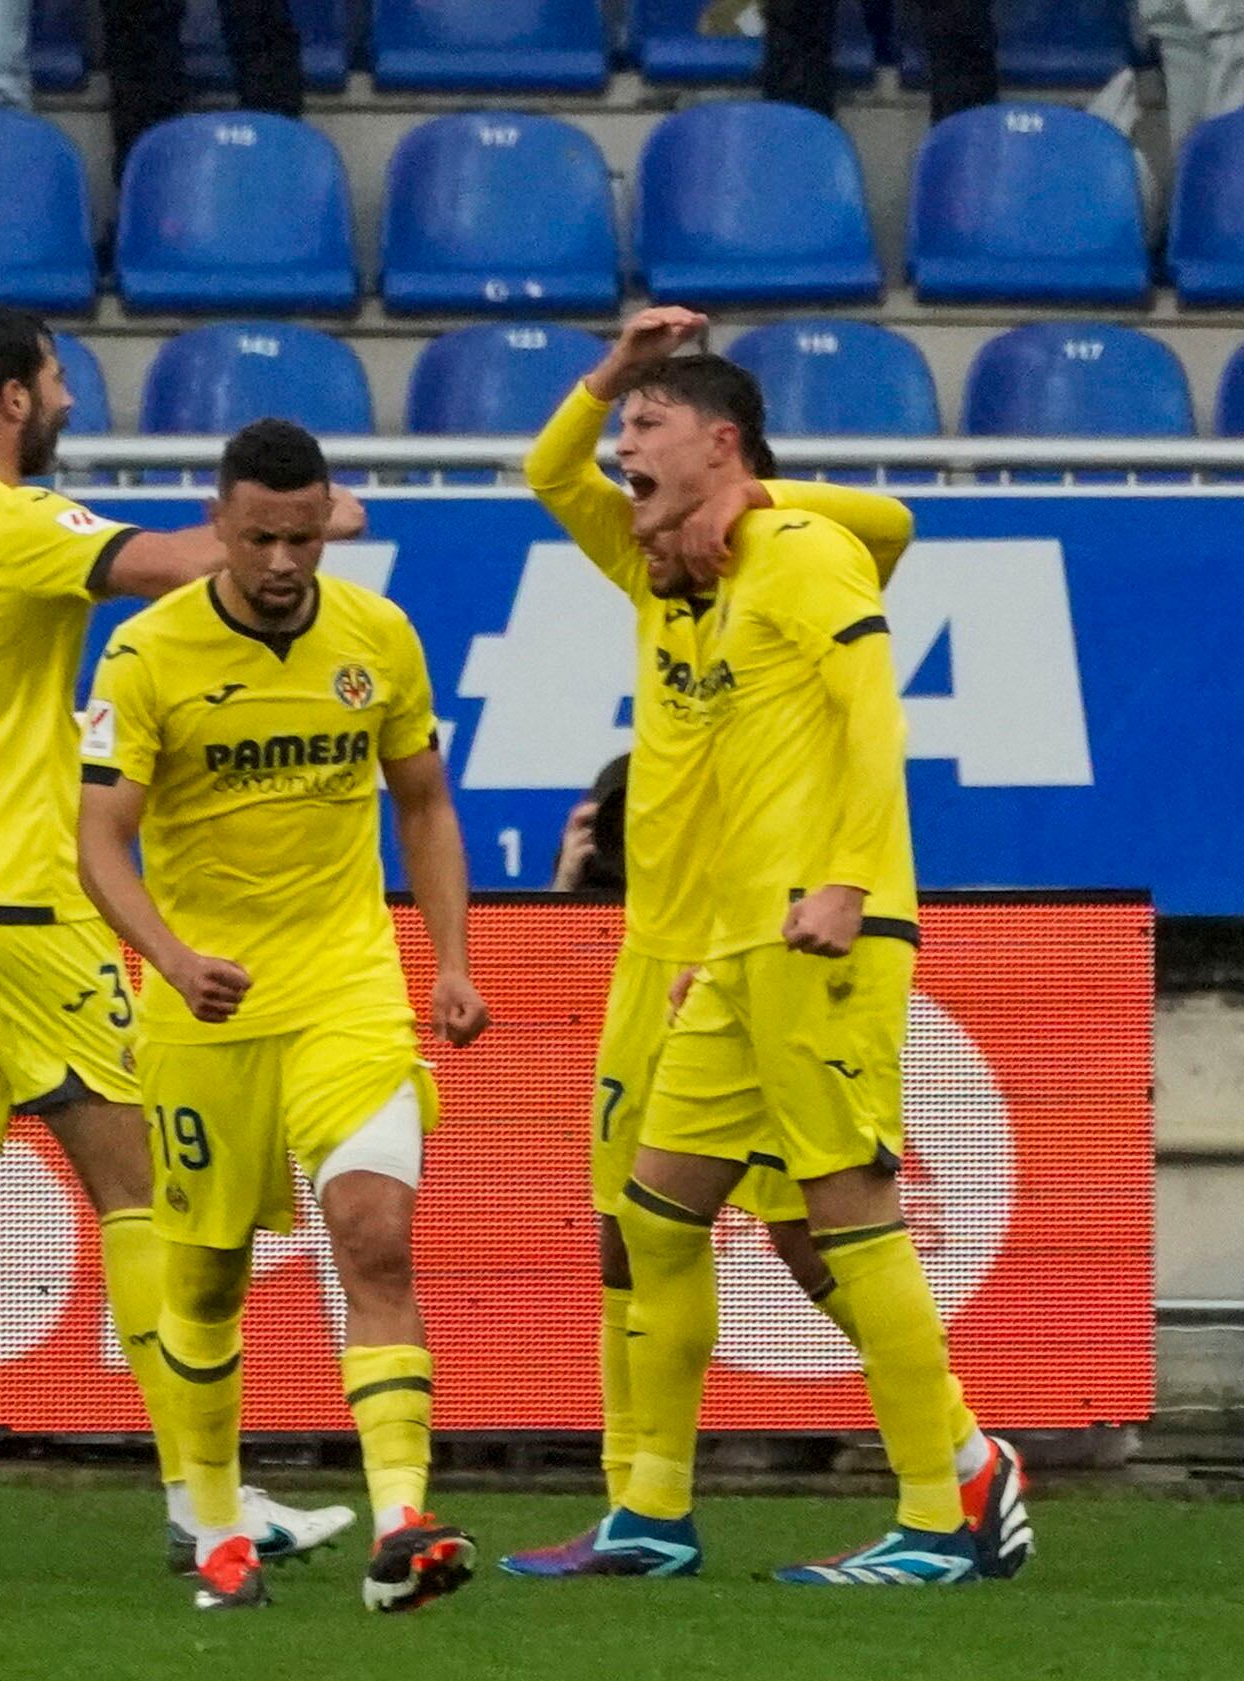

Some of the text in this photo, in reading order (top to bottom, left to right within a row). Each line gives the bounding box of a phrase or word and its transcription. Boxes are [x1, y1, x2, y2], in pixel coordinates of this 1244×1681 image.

[204, 730, 369, 771] PAMESA
[100, 964, 133, 1028] 3
[156, 1103, 212, 1170] 19
[599, 1076, 625, 1143] 7
